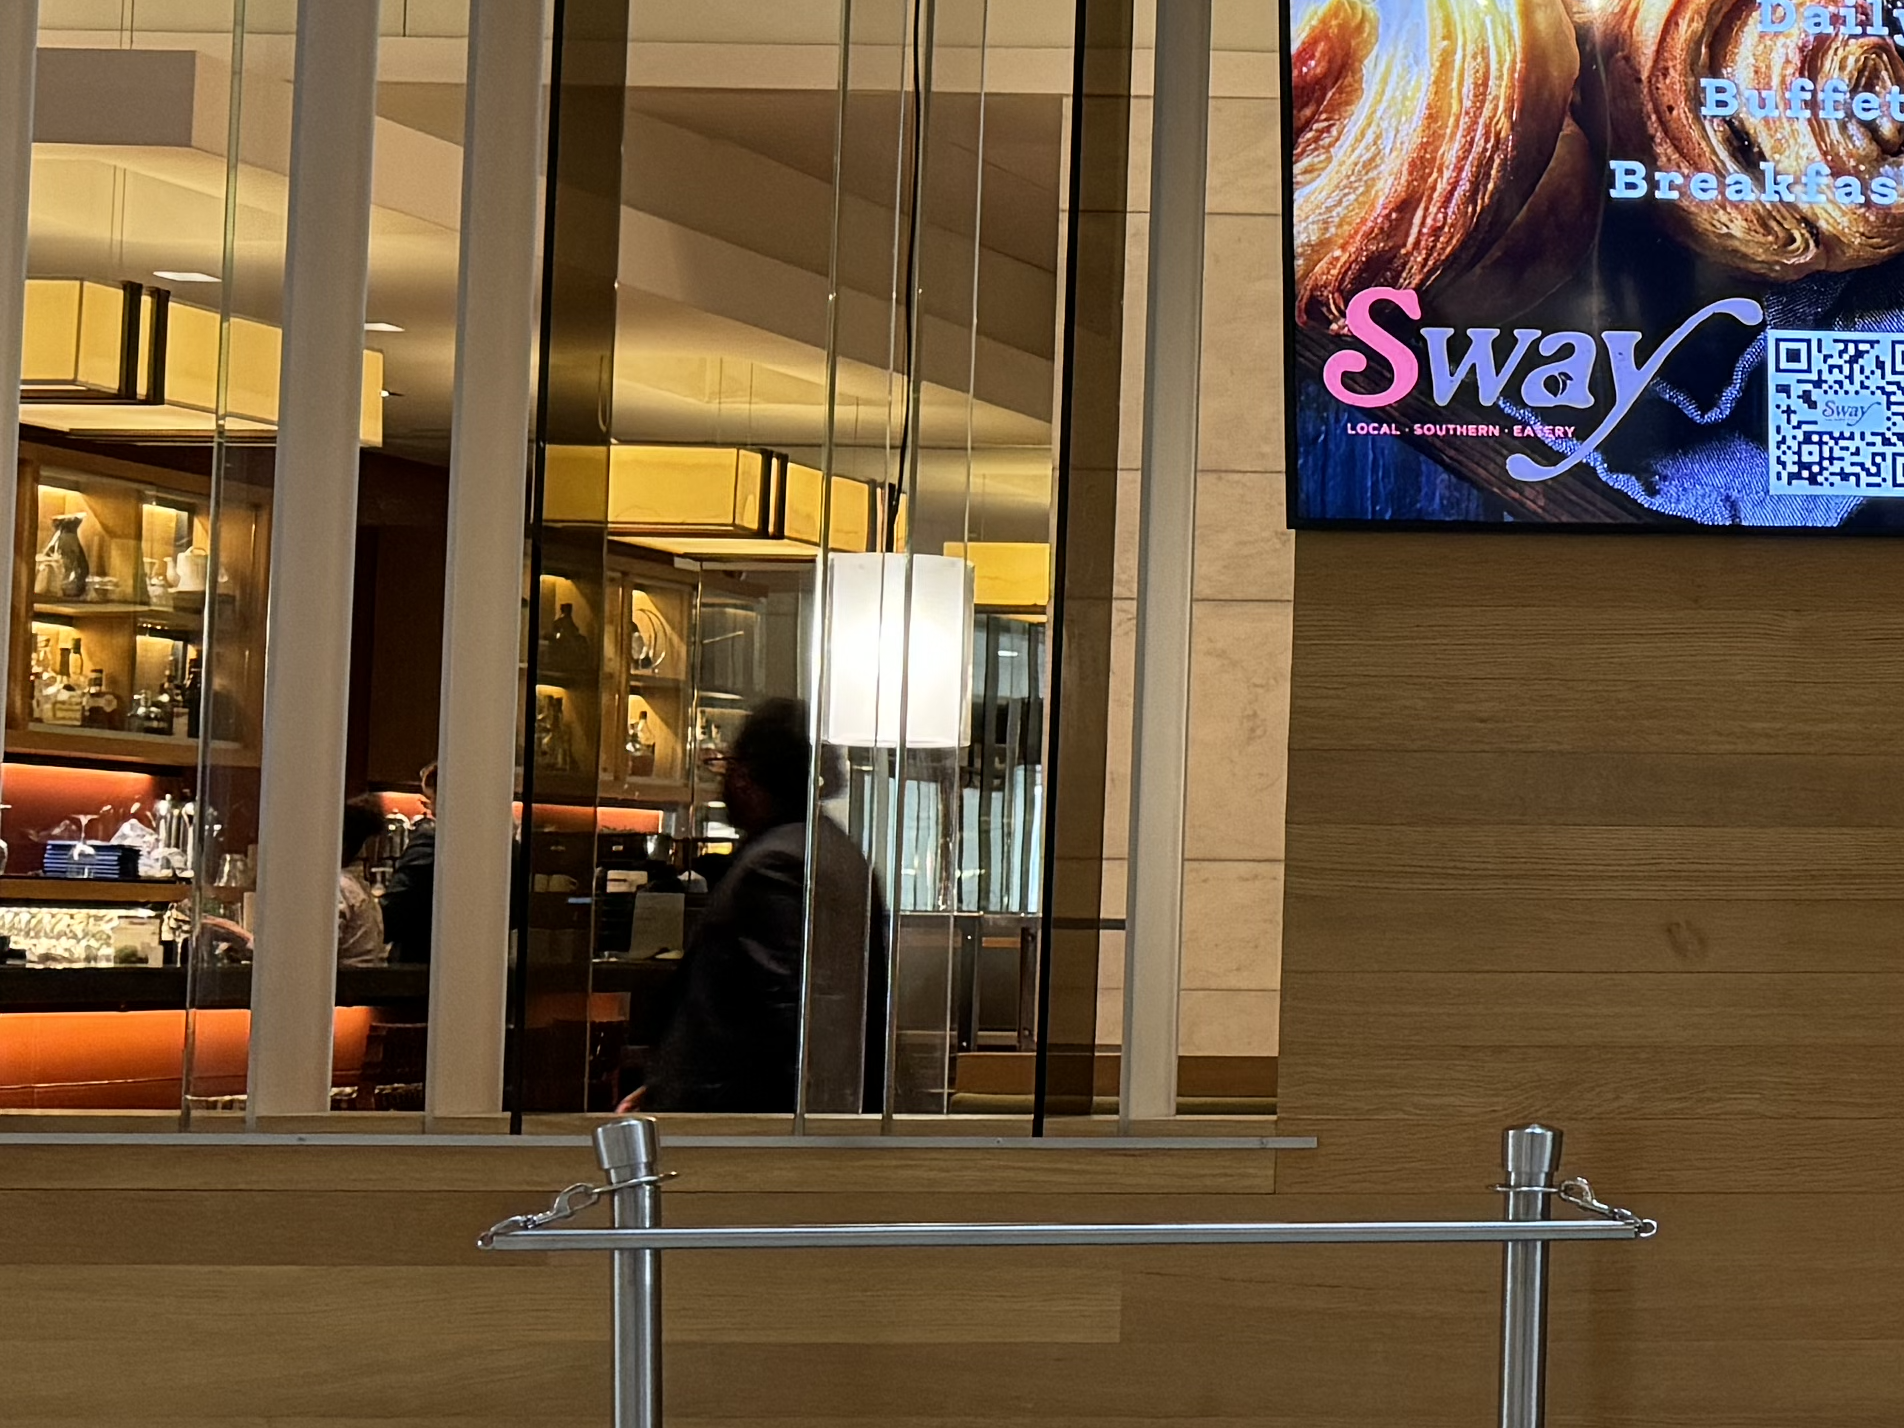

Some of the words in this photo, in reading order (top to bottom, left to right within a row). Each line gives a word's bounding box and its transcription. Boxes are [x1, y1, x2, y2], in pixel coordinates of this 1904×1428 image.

[1323, 286, 1764, 482] Sway
[1347, 422, 1401, 435] LOCAL
[1413, 423, 1500, 437] SOUTHERN
[1513, 425, 1576, 438] EATERY
